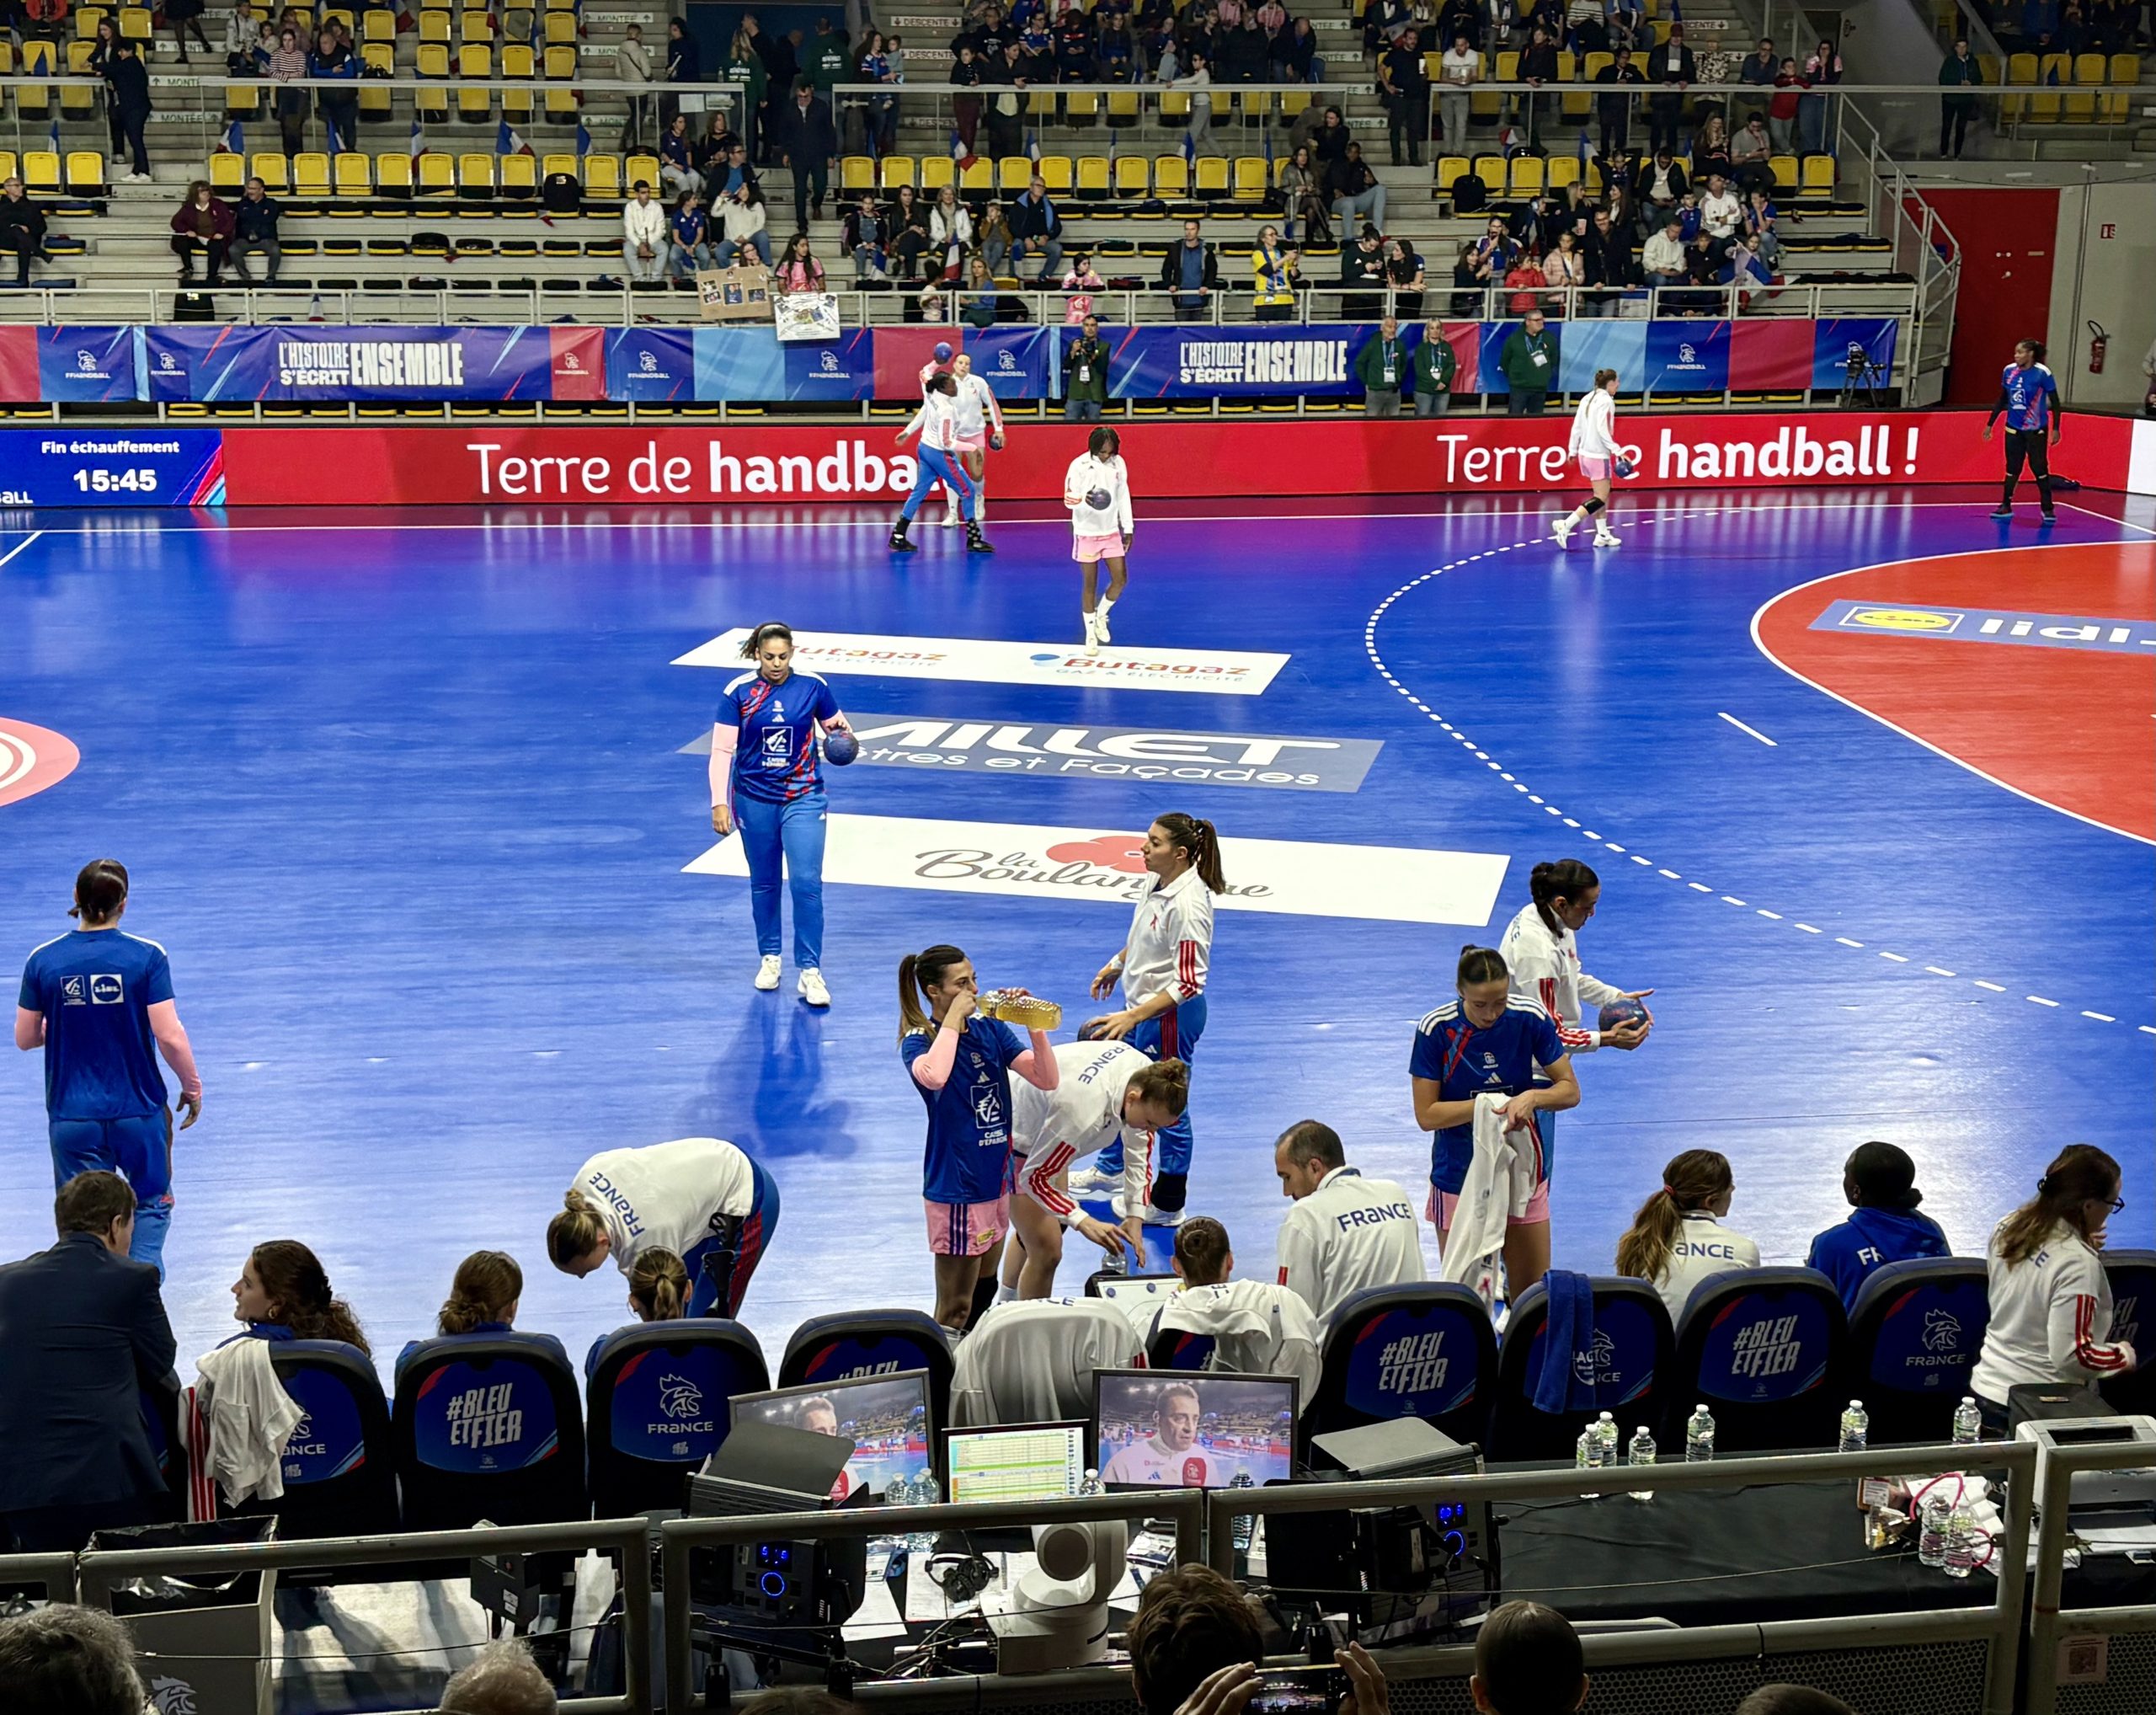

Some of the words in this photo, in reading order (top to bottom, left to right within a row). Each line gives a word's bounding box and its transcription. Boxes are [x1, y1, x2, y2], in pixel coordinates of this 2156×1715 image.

[279, 342, 349, 368] L'HISTOIRE
[350, 342, 463, 386] ENSEMBLE
[1180, 343, 1244, 367] L'HISTOIRE
[1245, 341, 1348, 383] ENSEMBLE
[280, 366, 350, 386] S'ÉCRIT
[1180, 365, 1245, 383] S'ÉCRIT
[41, 441, 67, 454] Fin
[70, 441, 179, 453] échauffement
[1437, 435, 1567, 483] Terre
[1658, 425, 1890, 479] handball
[467, 444, 610, 494] Terre
[628, 441, 691, 493] de
[710, 439, 940, 493] handba
[73, 469, 157, 492] 15:45
[792, 645, 947, 661] utagaz
[1064, 659, 1251, 675] Butagaz
[985, 756, 1037, 770] et
[1060, 759, 1320, 787] Façades
[999, 852, 1039, 868] la
[1733, 1315, 1799, 1350] #BLEU
[1379, 1331, 1445, 1366] #BLEU
[446, 1382, 513, 1421] #BLEU
